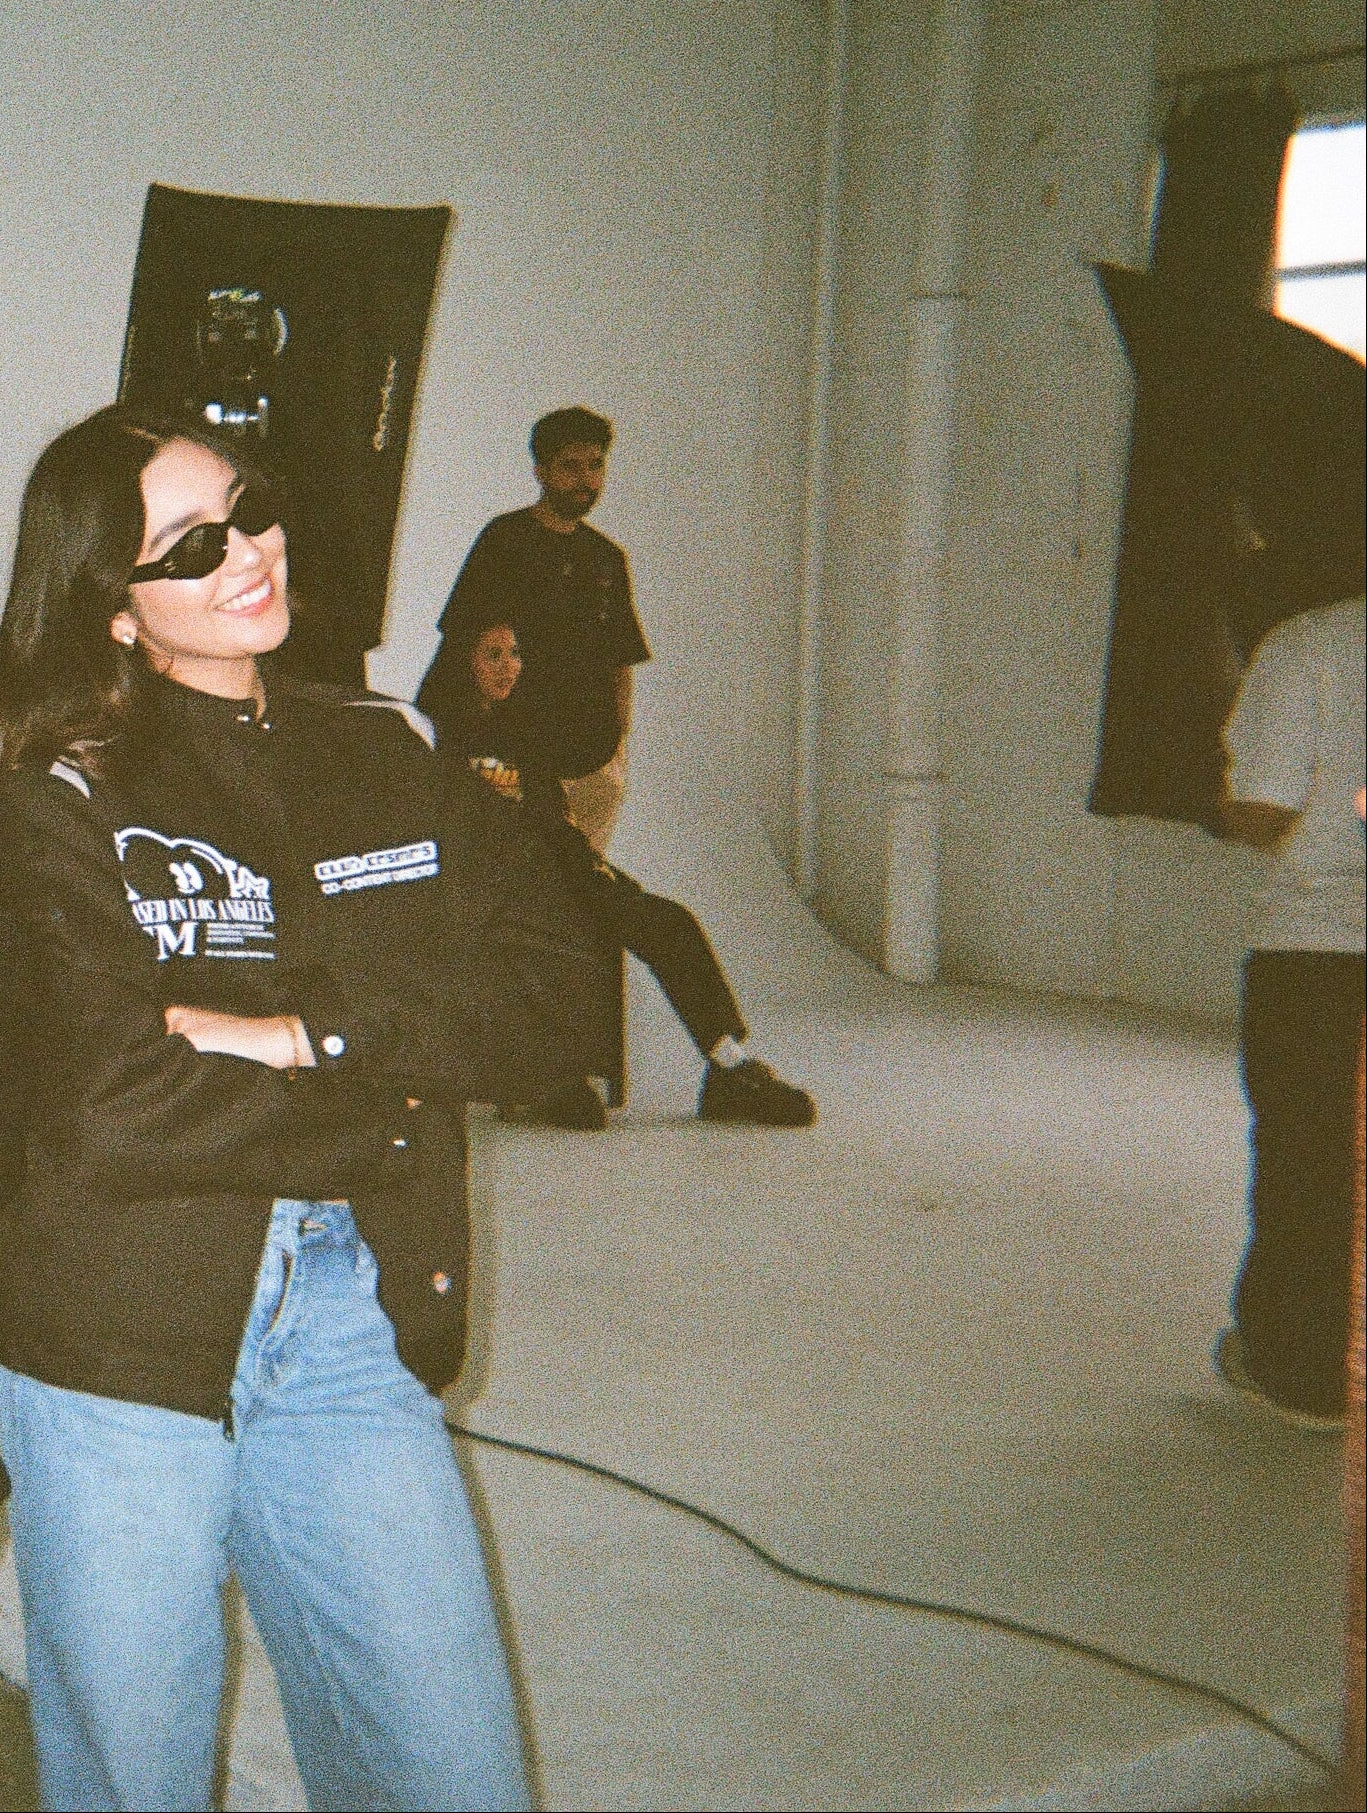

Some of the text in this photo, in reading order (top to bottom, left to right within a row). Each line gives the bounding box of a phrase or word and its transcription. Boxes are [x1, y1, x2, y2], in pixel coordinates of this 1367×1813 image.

[168, 898, 188, 921] IN
[188, 898, 217, 919] LOS
[218, 899, 274, 923] ANGELES
